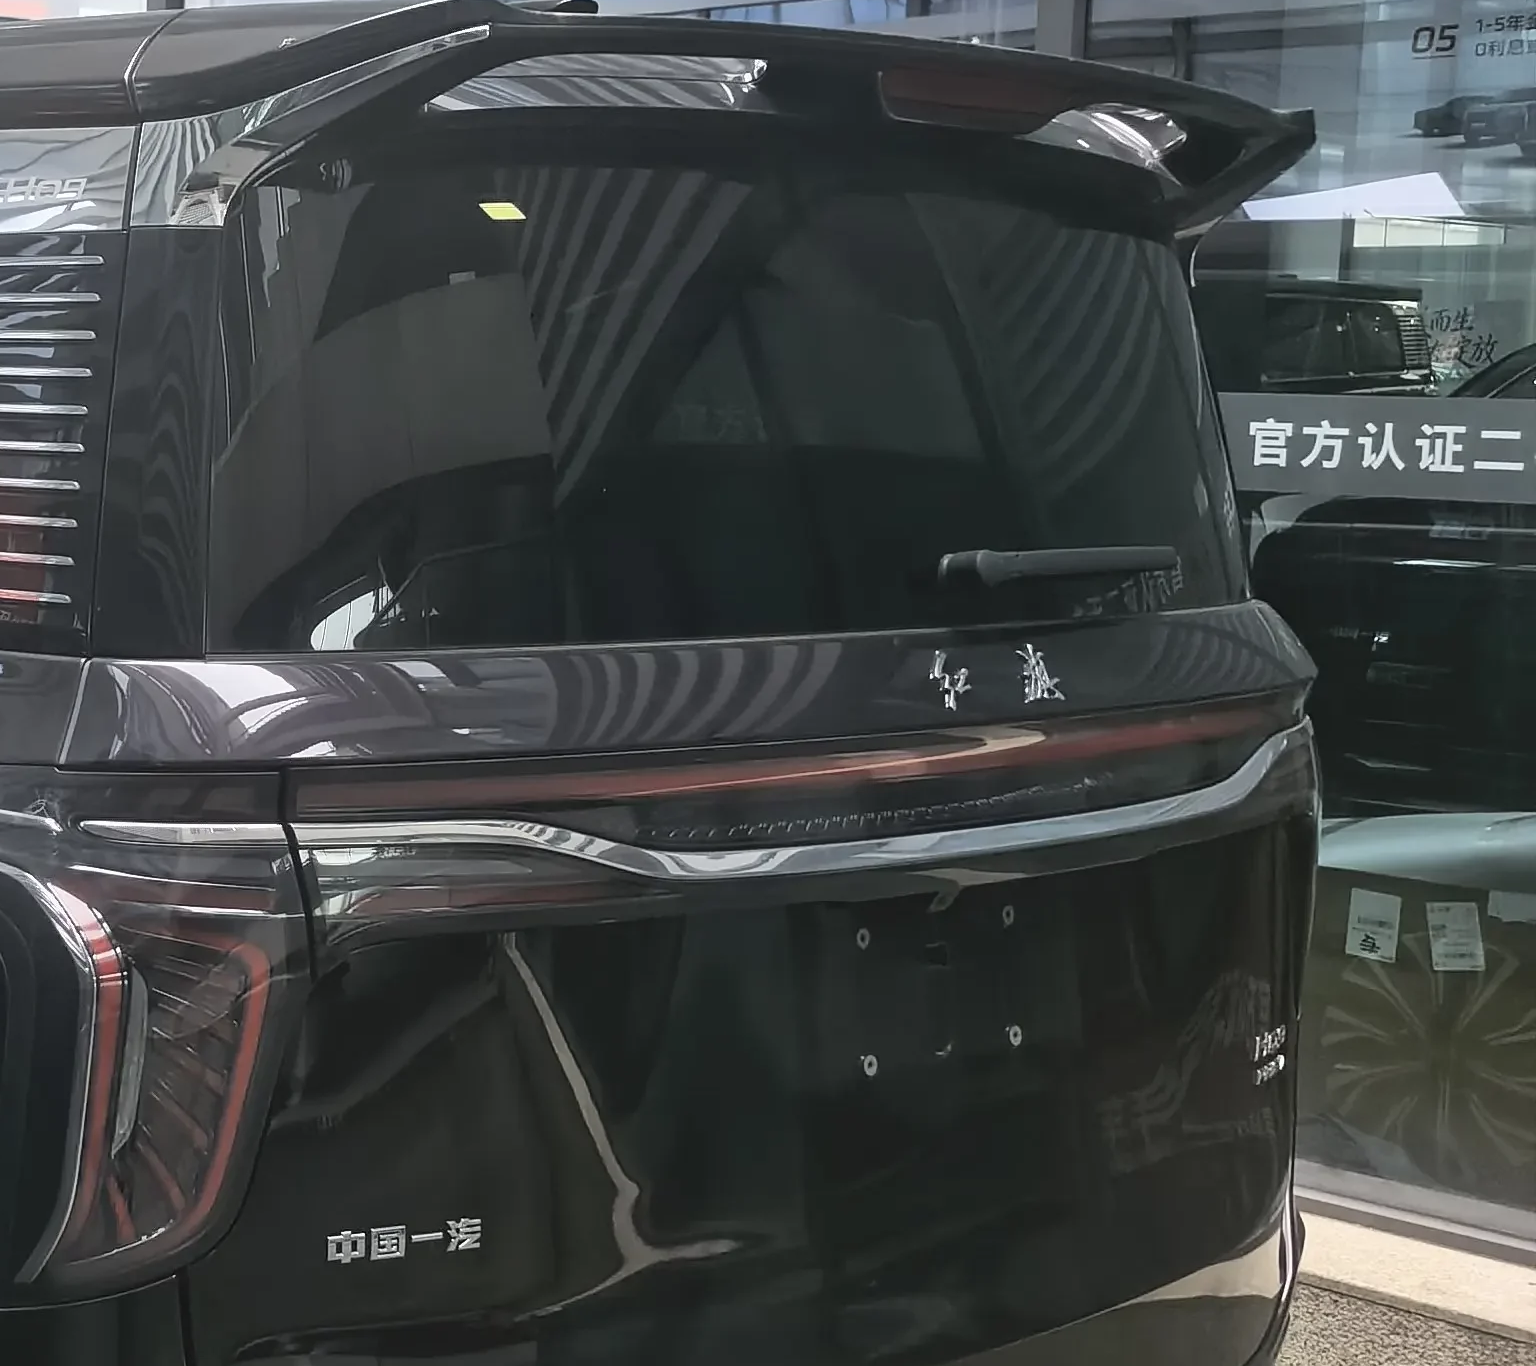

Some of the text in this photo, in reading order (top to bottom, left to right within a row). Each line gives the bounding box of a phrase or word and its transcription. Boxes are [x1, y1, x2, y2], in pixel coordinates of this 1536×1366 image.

[1411, 23, 1459, 53] 05
[1249, 418, 1525, 473] 官方认证二
[326, 1216, 482, 1264] 中国一汽
